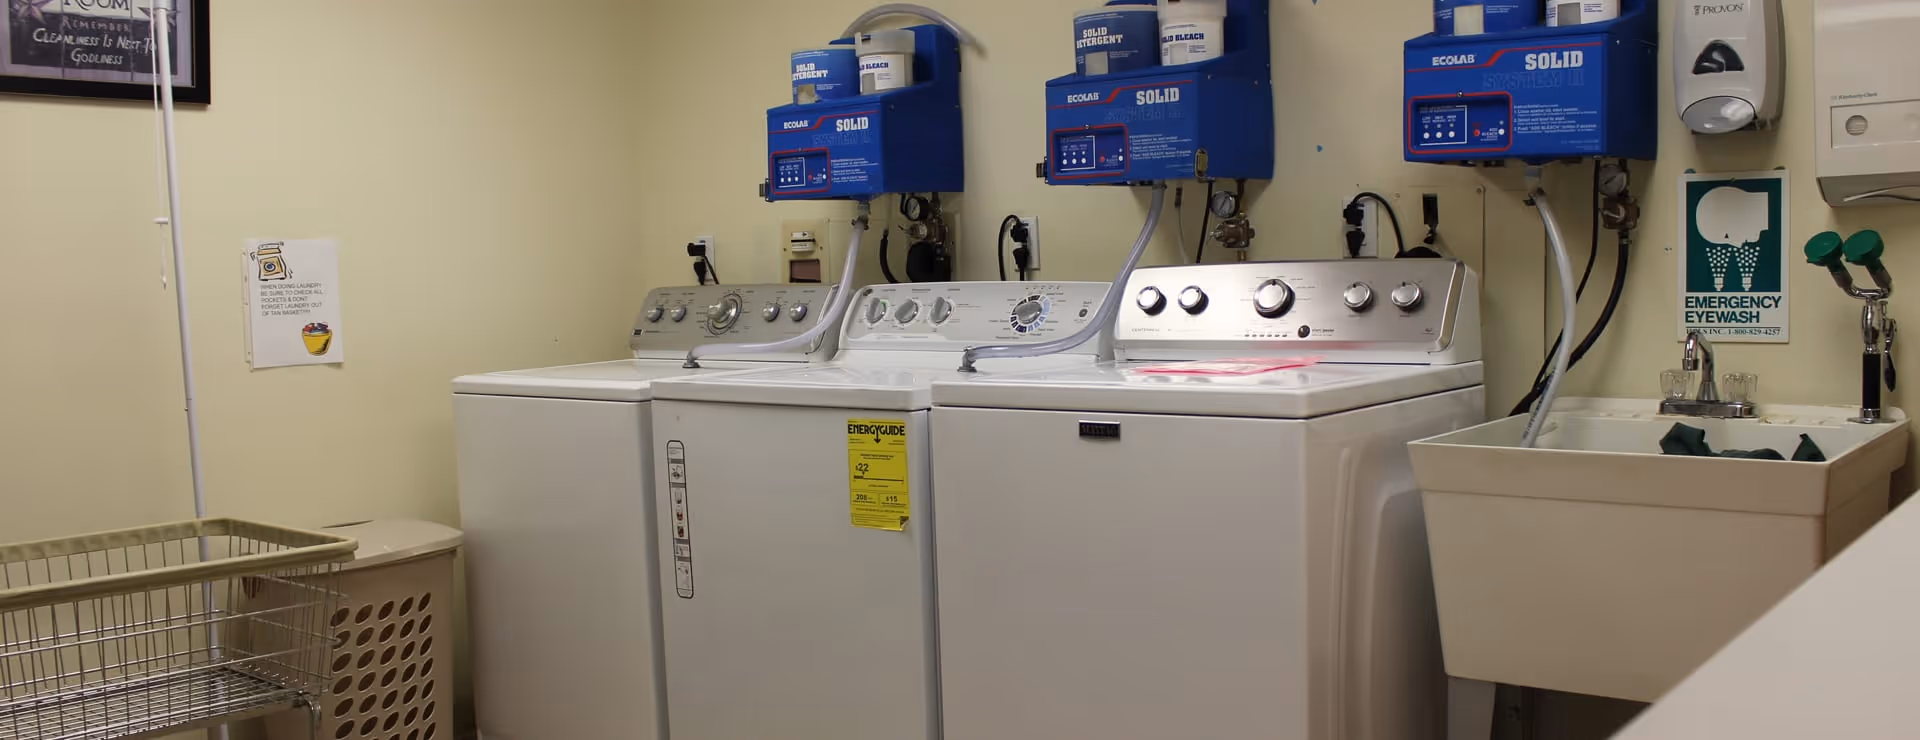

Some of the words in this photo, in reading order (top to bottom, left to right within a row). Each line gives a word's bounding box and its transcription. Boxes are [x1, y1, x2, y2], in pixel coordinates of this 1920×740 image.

[1702, 4, 1745, 15] PROVON
[1082, 26, 1108, 38] SOLID
[1175, 32, 1204, 41] BLEACH
[1432, 54, 1475, 66] ECOLAB
[1525, 50, 1583, 71] SOLID
[796, 63, 816, 73] SOLID
[1067, 92, 1100, 103] ECOLAB
[1136, 87, 1180, 105] SOLID
[783, 119, 809, 129] ECOLAB
[836, 116, 869, 132] SOLID
[1684, 295, 1782, 309] EMERGENCY
[1684, 310, 1760, 324] EYEWASH
[1728, 328, 1781, 336] 1-800-829-4257
